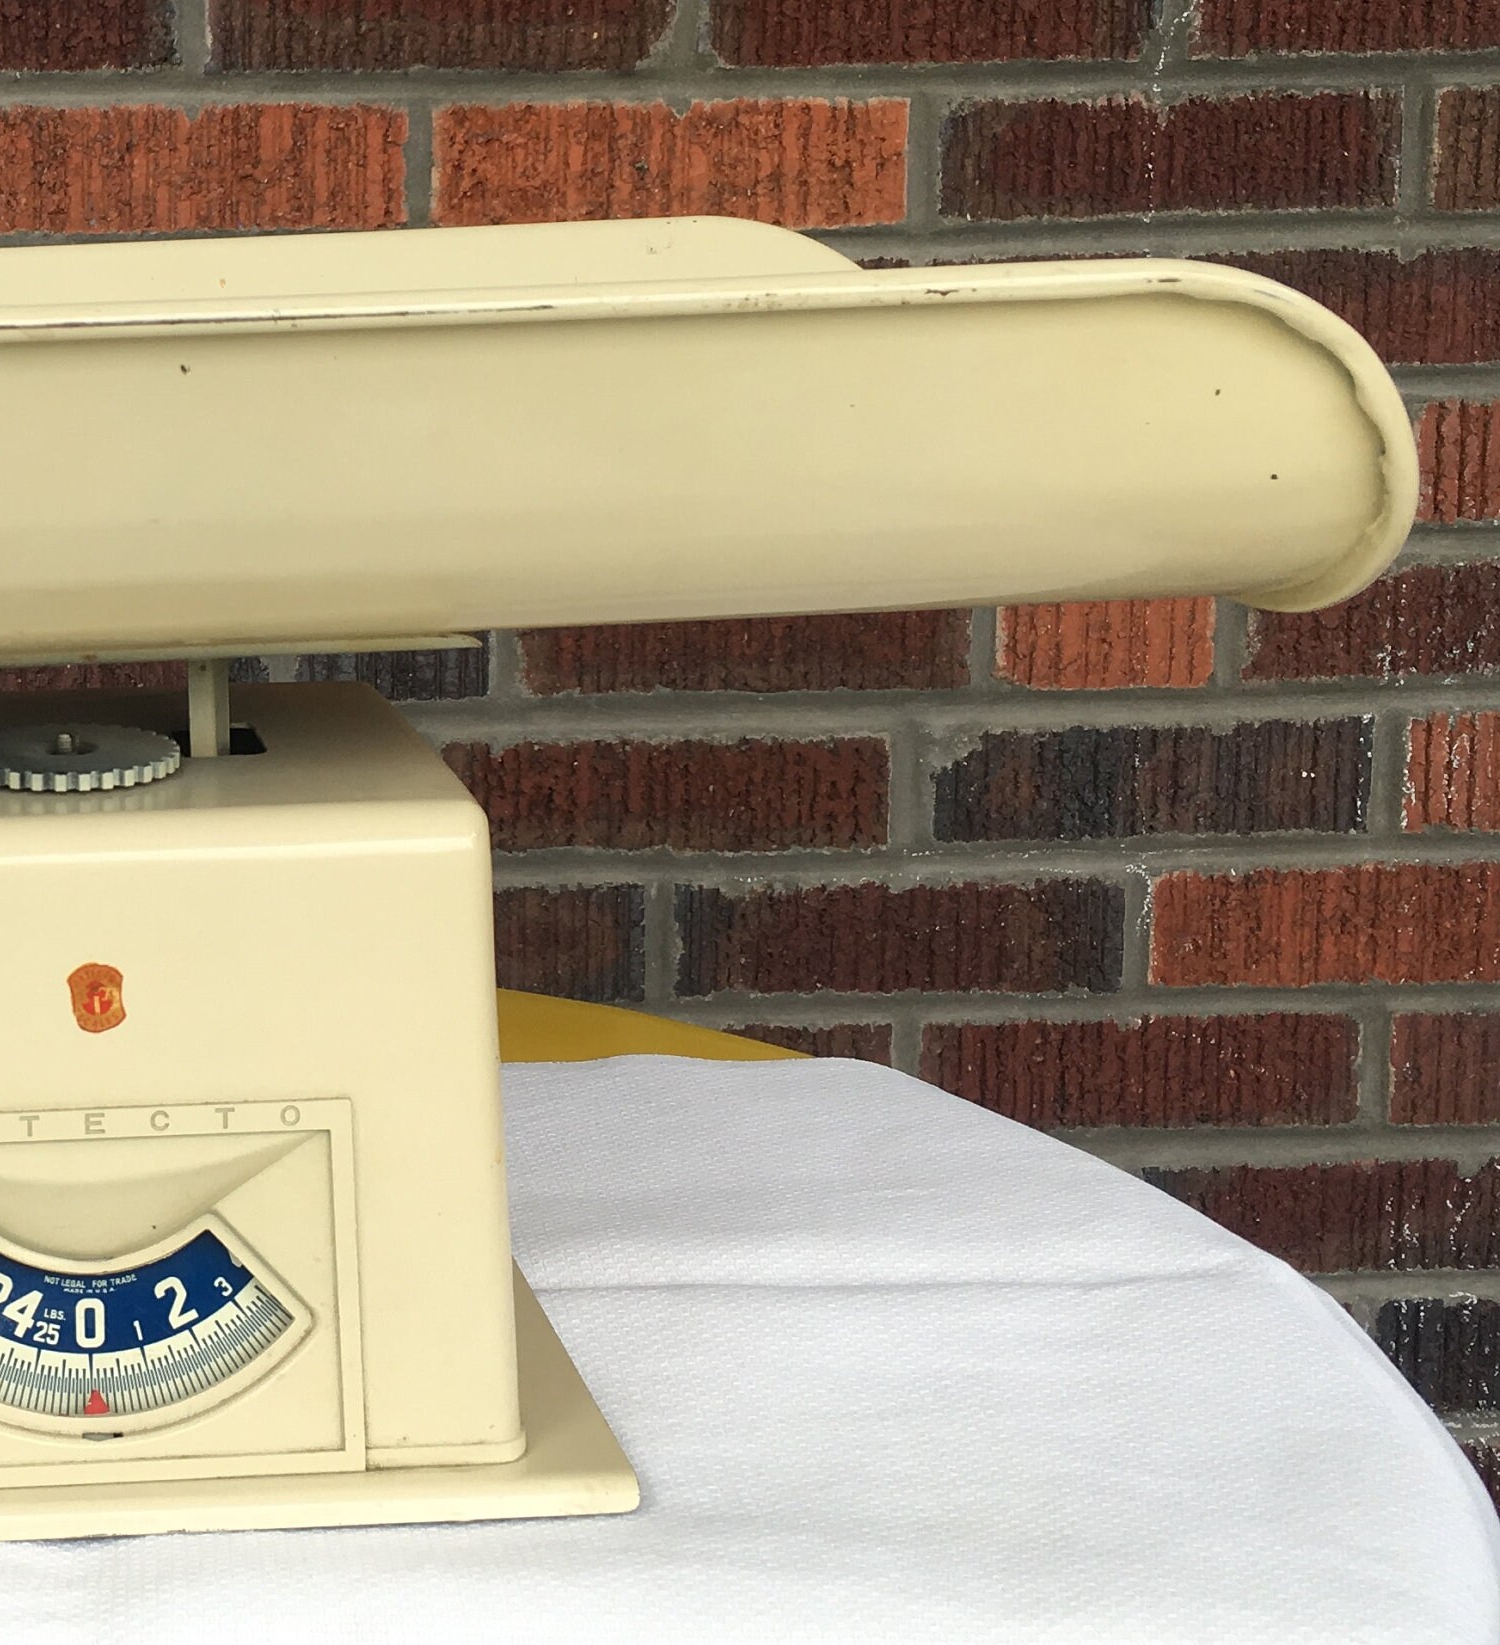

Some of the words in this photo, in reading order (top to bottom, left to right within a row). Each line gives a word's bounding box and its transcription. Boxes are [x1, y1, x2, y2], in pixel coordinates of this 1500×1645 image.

[43, 1274, 60, 1286] NOT
[60, 1278, 86, 1289] LEGAL
[91, 1279, 108, 1288] FOR
[110, 1273, 138, 1286] TRADE
[212, 1276, 233, 1297] 3
[43, 1307, 66, 1321] LBS.
[153, 1276, 200, 1330] 2
[32, 1321, 61, 1345] 25
[75, 1297, 106, 1348] 0
[132, 1319, 144, 1341] 1
